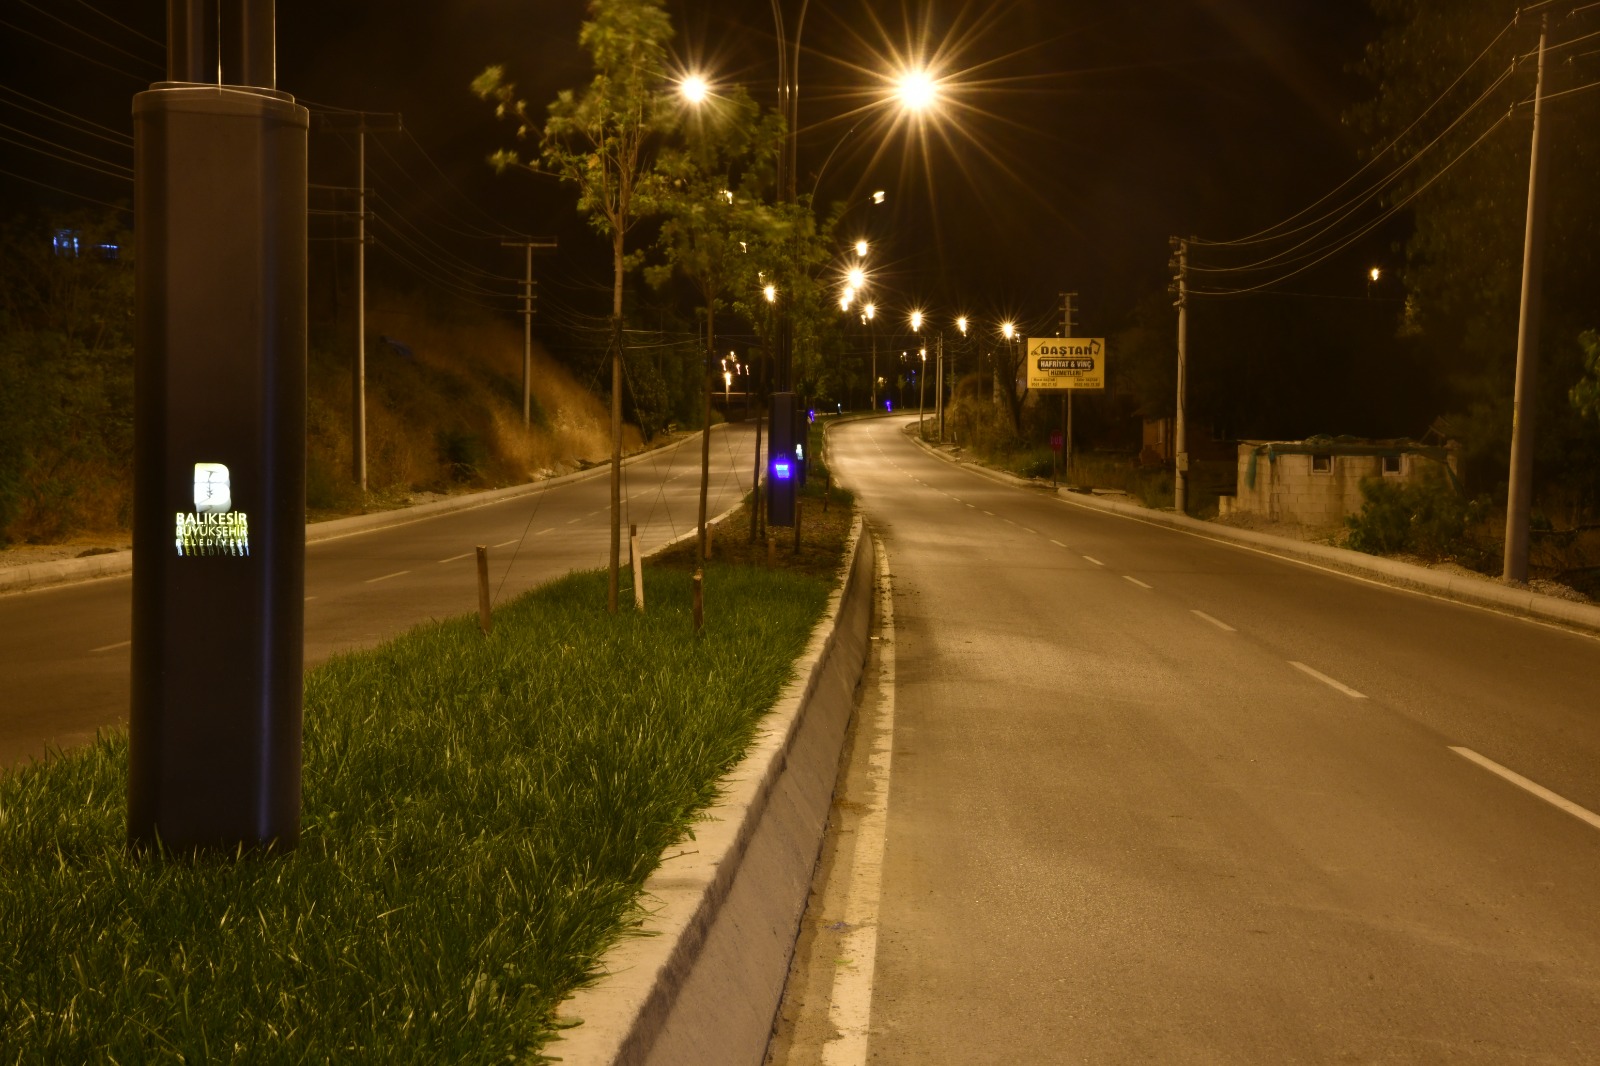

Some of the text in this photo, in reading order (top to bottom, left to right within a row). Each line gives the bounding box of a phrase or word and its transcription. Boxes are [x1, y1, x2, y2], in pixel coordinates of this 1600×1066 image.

[1041, 346, 1092, 356] DAŞTAN
[1041, 360, 1069, 368] HAFRİYAT
[1077, 360, 1091, 368] VİNÇ
[176, 511, 247, 525] BALIKESİR
[176, 525, 247, 538] BÜYÜKŞEHİR
